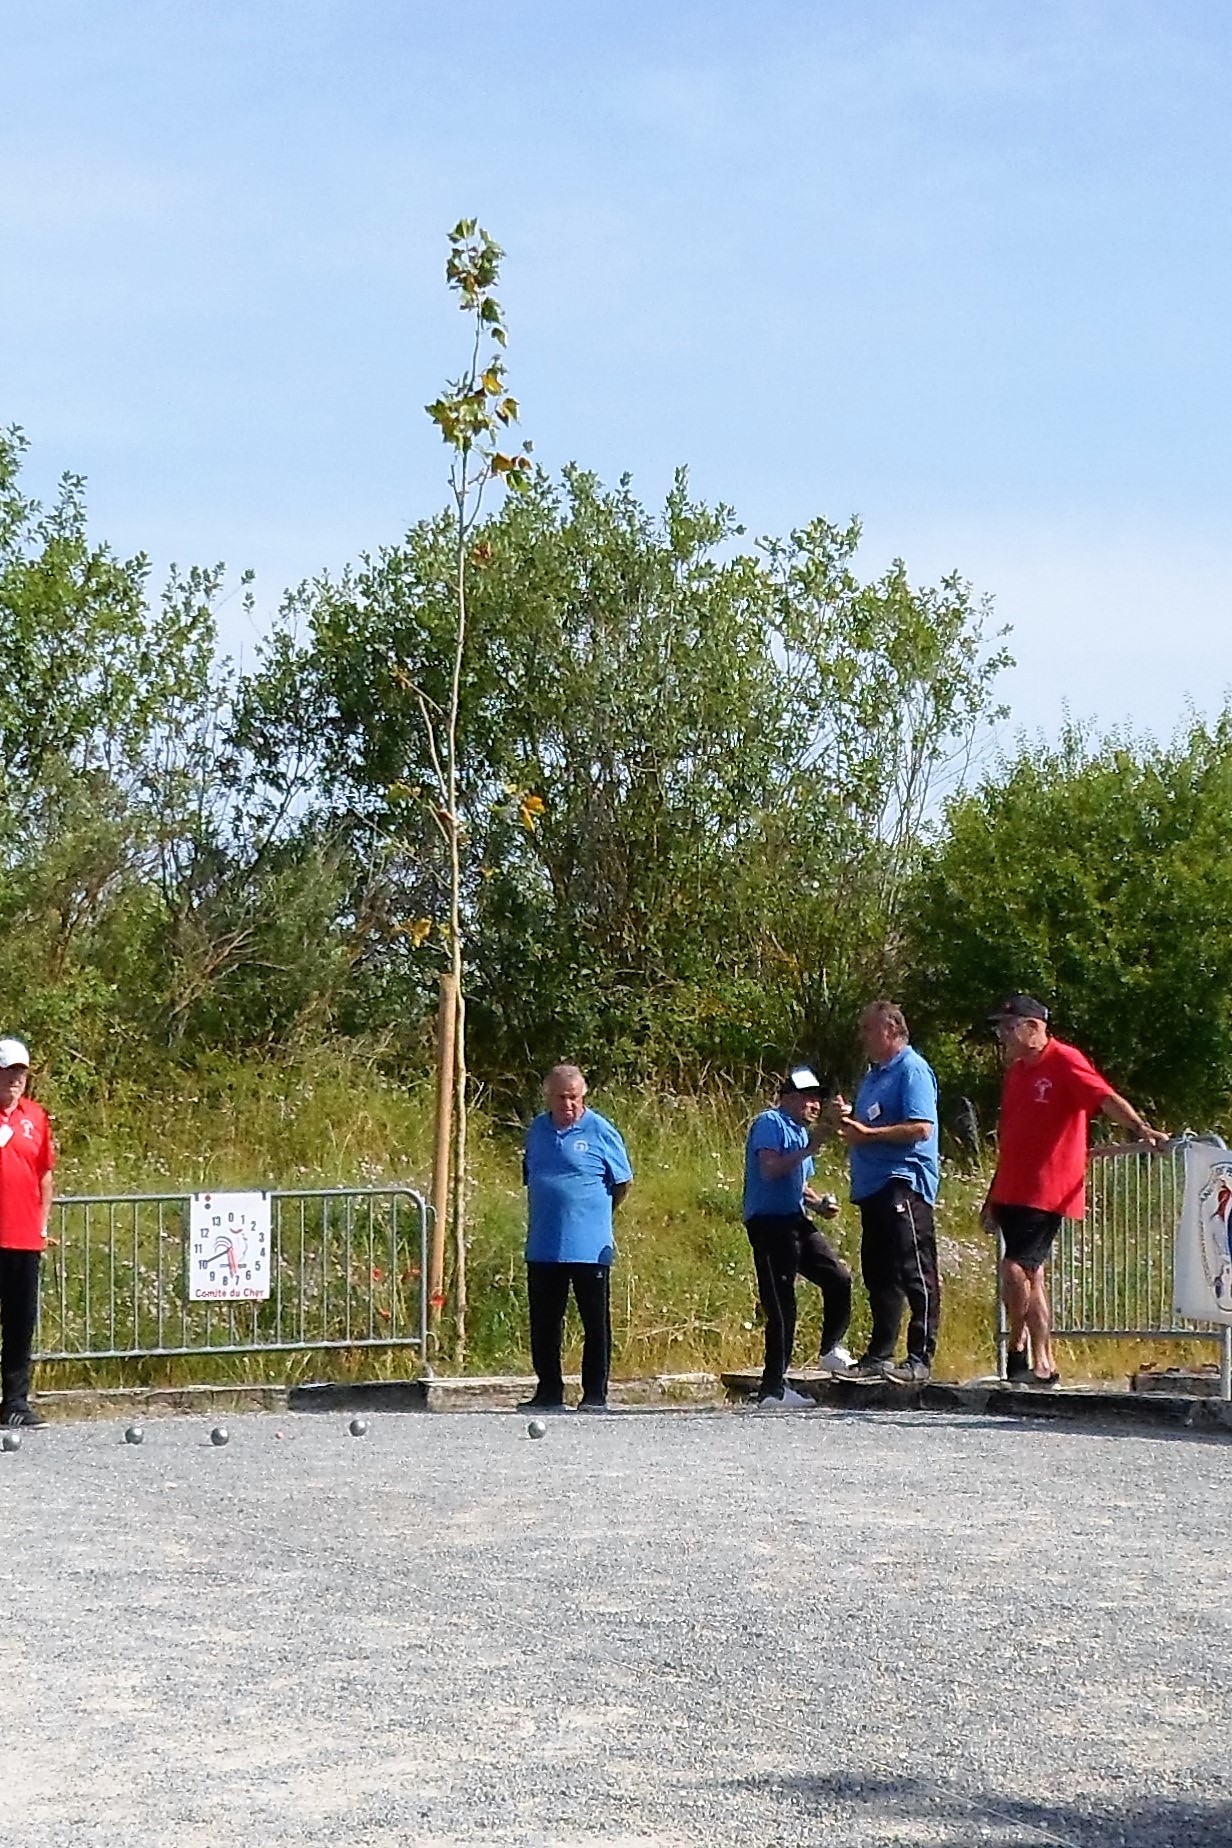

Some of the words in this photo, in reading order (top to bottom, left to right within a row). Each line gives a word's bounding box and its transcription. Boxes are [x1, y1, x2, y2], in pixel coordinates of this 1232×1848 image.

[212, 1216, 221, 1226] 13
[228, 1212, 234, 1222] 0
[241, 1215, 245, 1225] 1
[251, 1221, 257, 1231] 2
[200, 1228, 210, 1238] 12
[259, 1232, 265, 1242] 3
[195, 1244, 202, 1254] 11
[260, 1247, 266, 1257] 4
[199, 1260, 208, 1270] 10
[255, 1261, 261, 1271] 5
[209, 1271, 215, 1281] 9
[235, 1275, 240, 1286] 7
[245, 1270, 252, 1281] 6
[222, 1276, 228, 1286] 8
[229, 1289, 241, 1297] du
